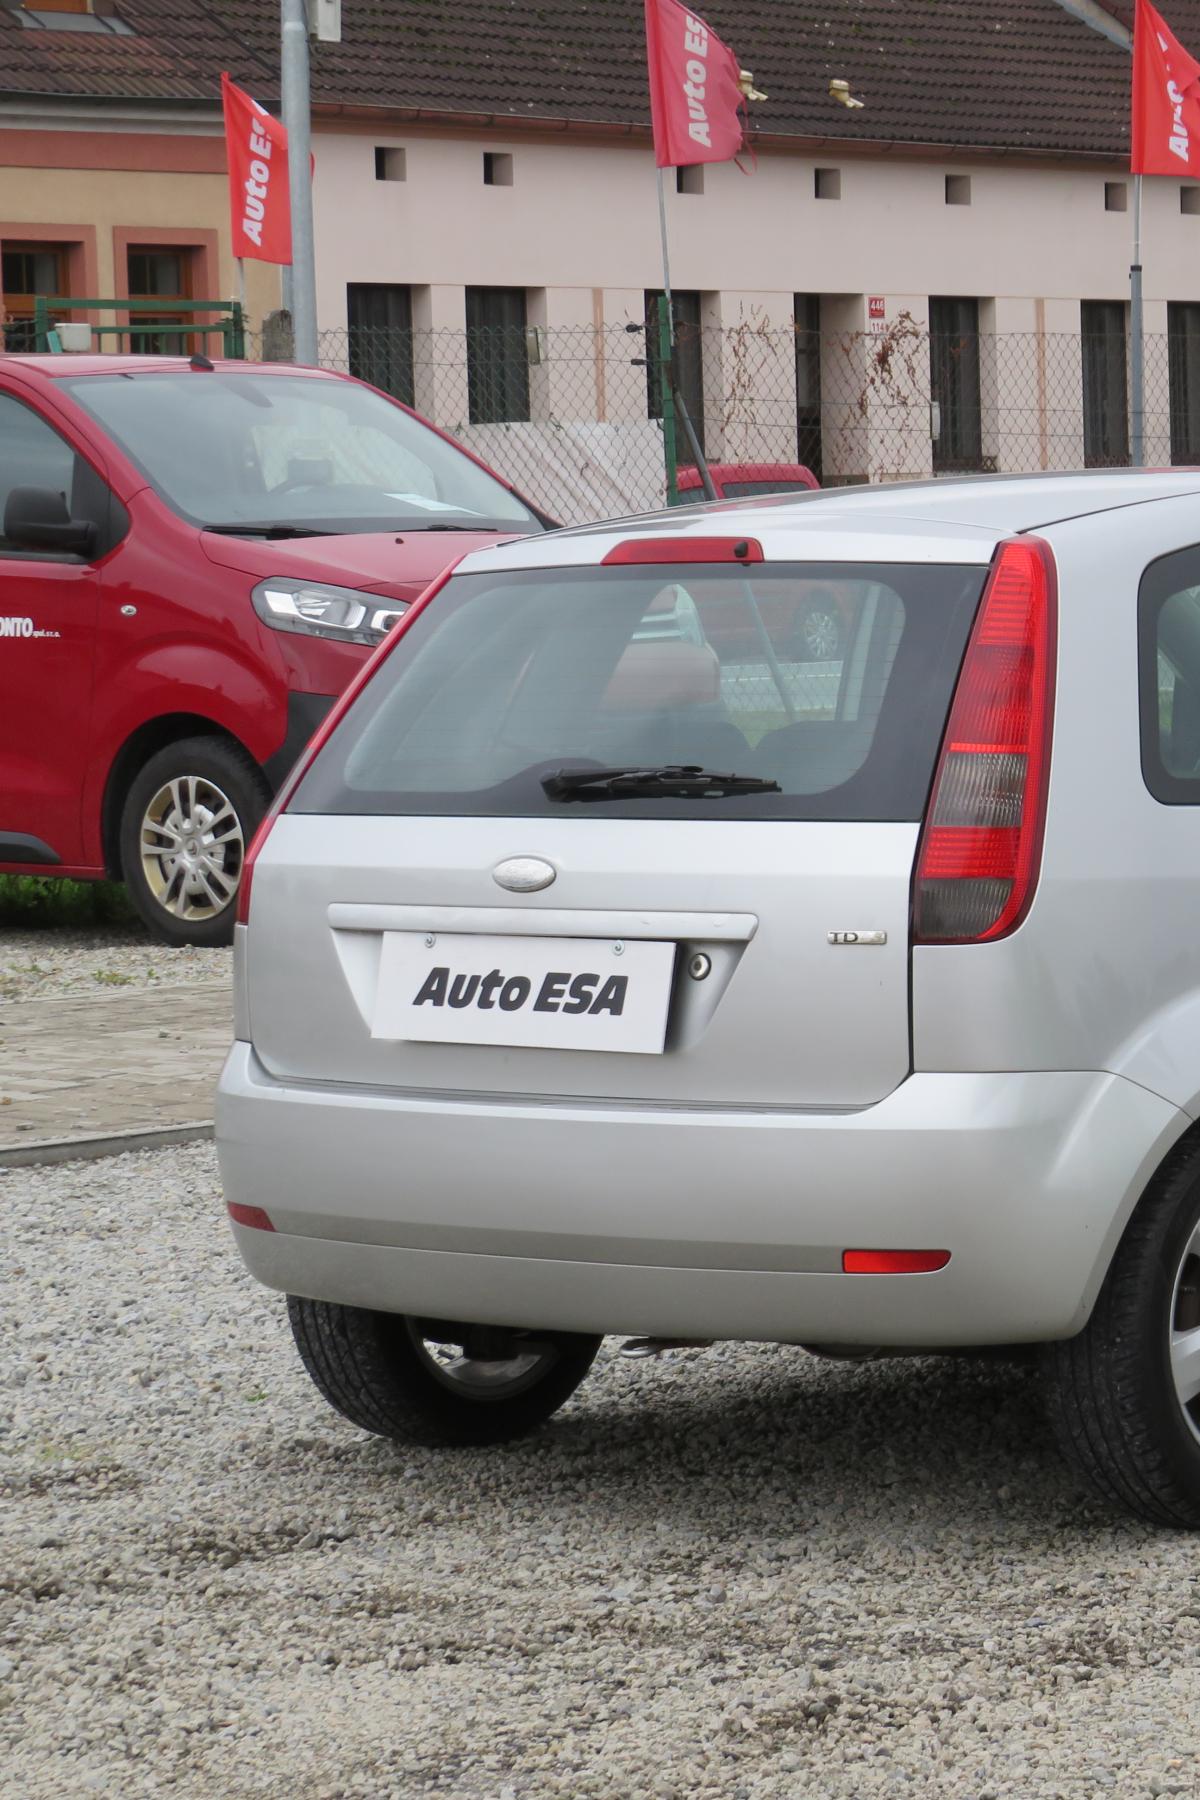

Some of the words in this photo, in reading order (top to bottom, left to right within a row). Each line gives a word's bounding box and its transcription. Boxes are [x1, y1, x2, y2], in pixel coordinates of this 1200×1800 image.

[684, 15, 709, 58] ES
[683, 59, 712, 148] Auto
[242, 159, 270, 247] Auto
[412, 967, 531, 1012] Auto
[533, 972, 629, 1016] ESA
